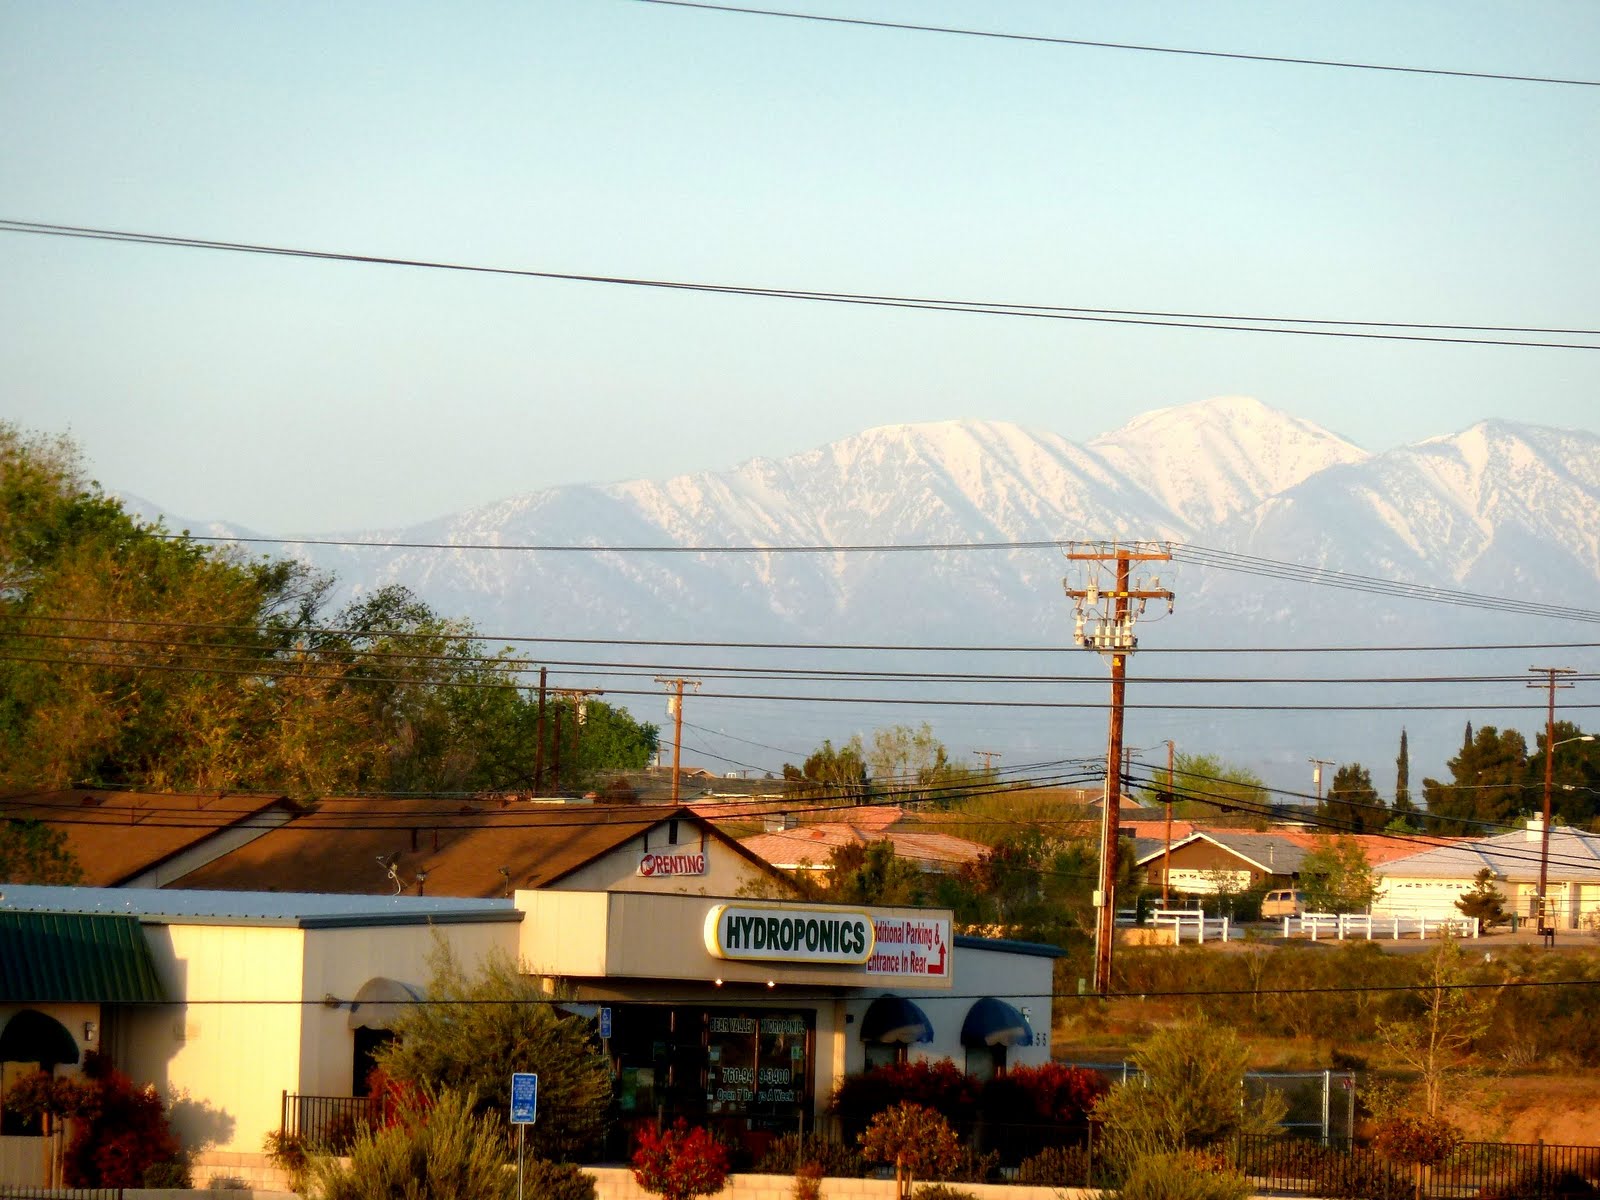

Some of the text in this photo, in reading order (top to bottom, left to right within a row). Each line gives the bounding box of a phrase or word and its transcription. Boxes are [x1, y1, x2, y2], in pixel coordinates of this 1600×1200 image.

[655, 855, 705, 874] RENTING
[726, 916, 865, 954] HYDROPONICS
[874, 920, 940, 951] dditional Parking &
[867, 950, 927, 974] Entrance In Rear
[709, 1017, 729, 1033] BEAR
[729, 1017, 756, 1034] VALLEY
[717, 1088, 736, 1103] Open
[774, 1088, 795, 1102] Week
